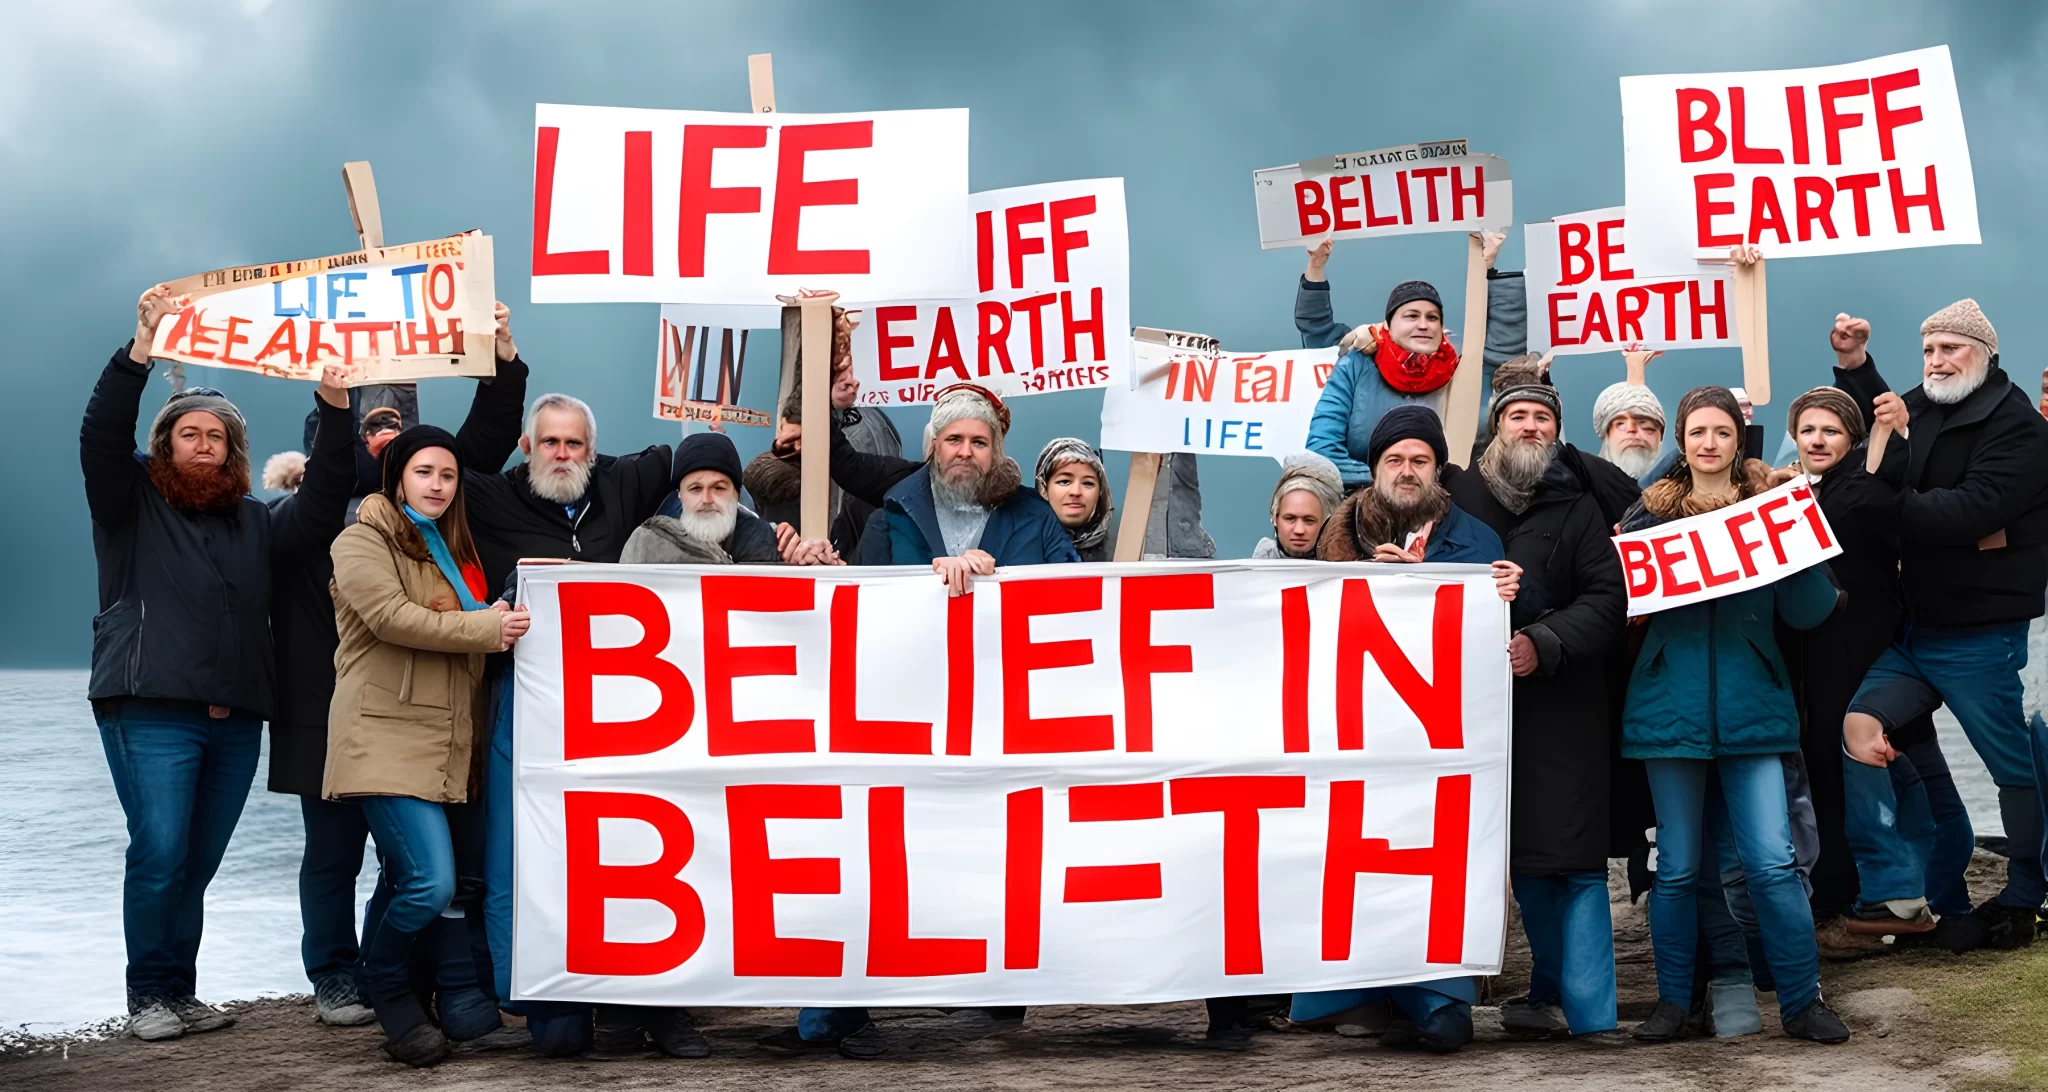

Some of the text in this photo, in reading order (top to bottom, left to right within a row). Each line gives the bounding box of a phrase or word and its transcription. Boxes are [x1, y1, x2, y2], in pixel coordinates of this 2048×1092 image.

[1676, 68, 1924, 166] BLIFF
[532, 120, 874, 279] LIFE
[1294, 166, 1485, 237] BELITH
[1694, 164, 1945, 248] EARTH
[876, 287, 1106, 382] EARTH
[1547, 280, 1729, 346] EARTH
[557, 572, 1465, 761] BELIEF IN
